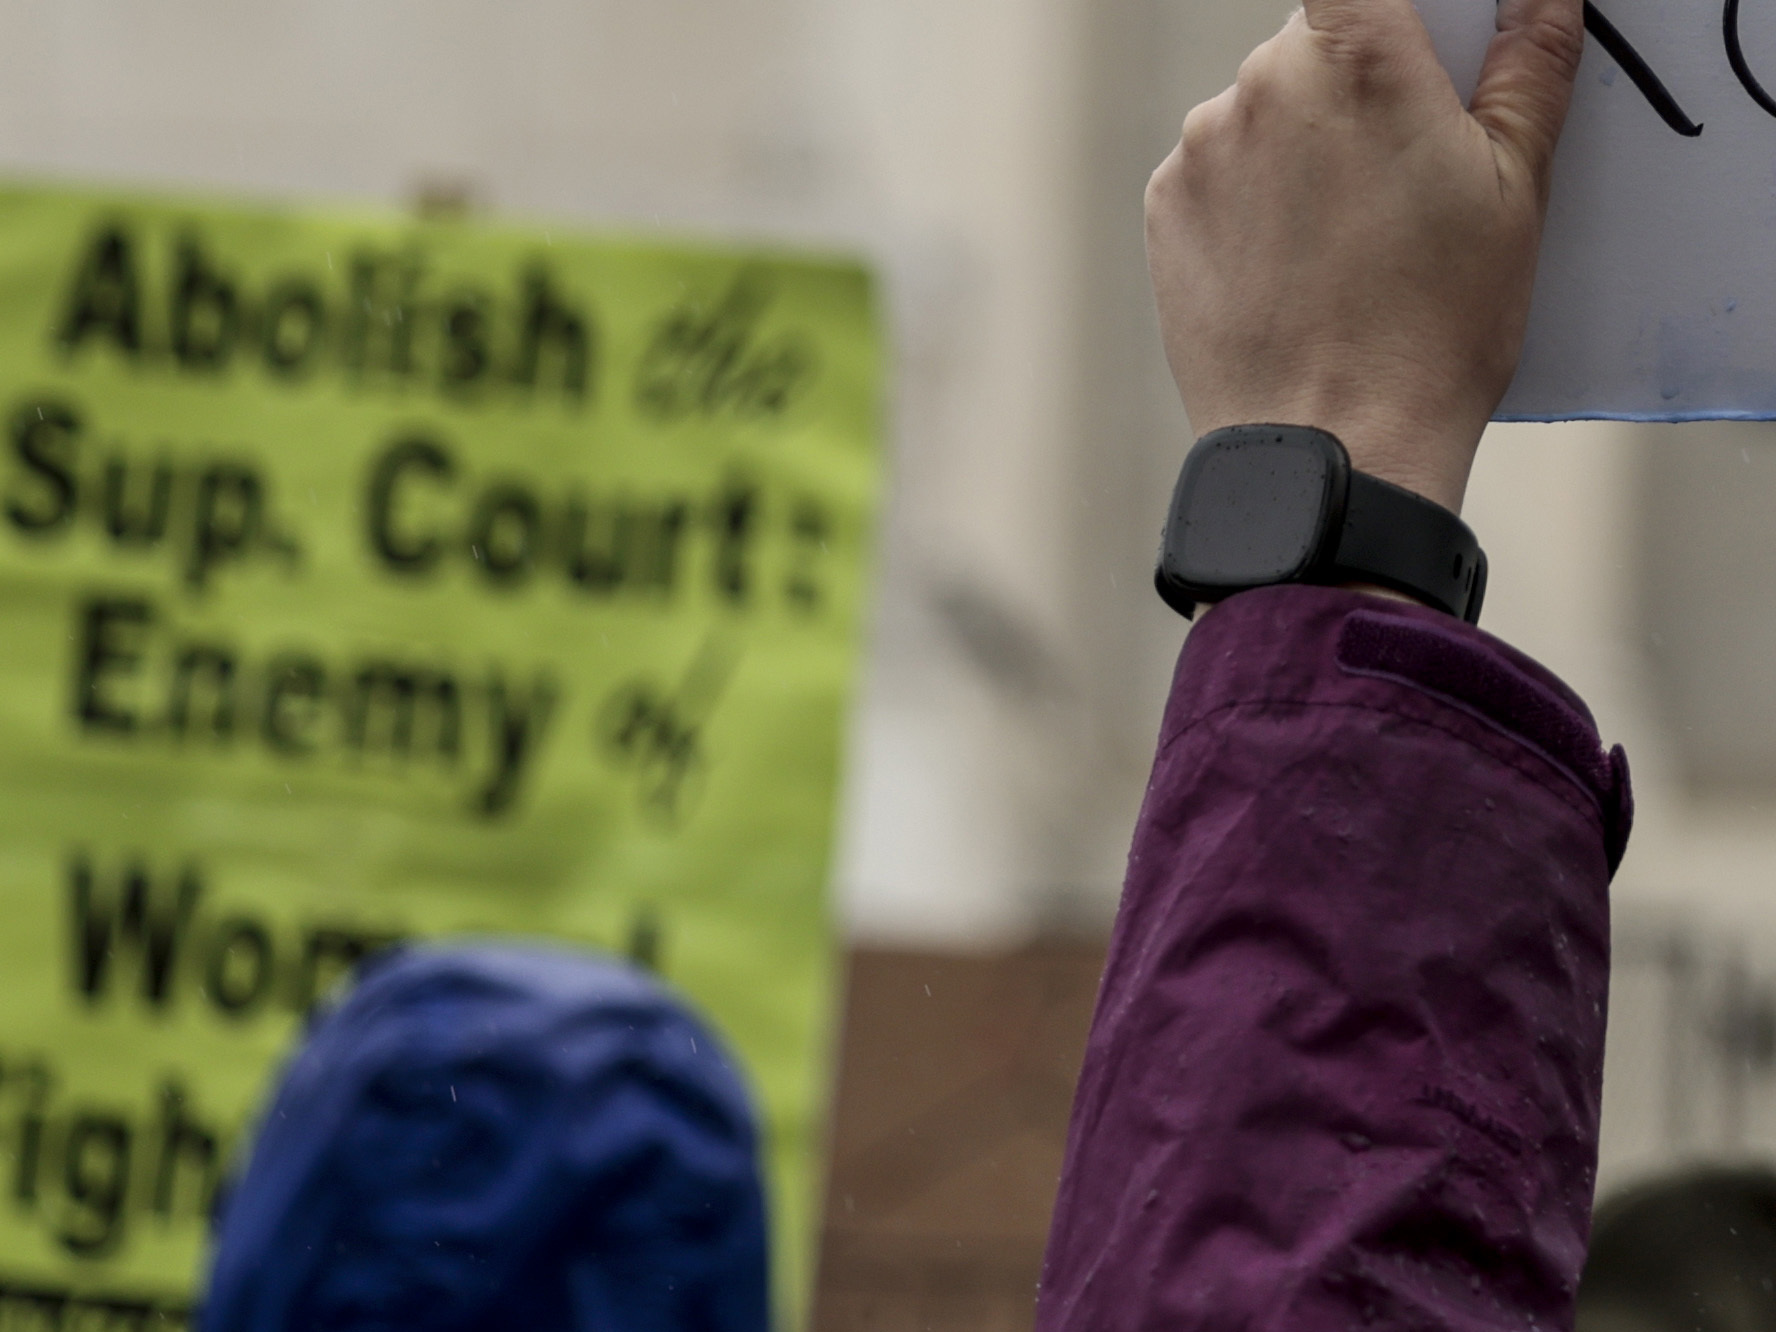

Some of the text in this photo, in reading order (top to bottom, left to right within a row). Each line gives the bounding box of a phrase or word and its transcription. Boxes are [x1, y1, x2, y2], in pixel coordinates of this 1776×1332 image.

[52, 216, 820, 428] Abolish the
[0, 396, 836, 620] Sup. Court:
[70, 594, 568, 826] Enemy
